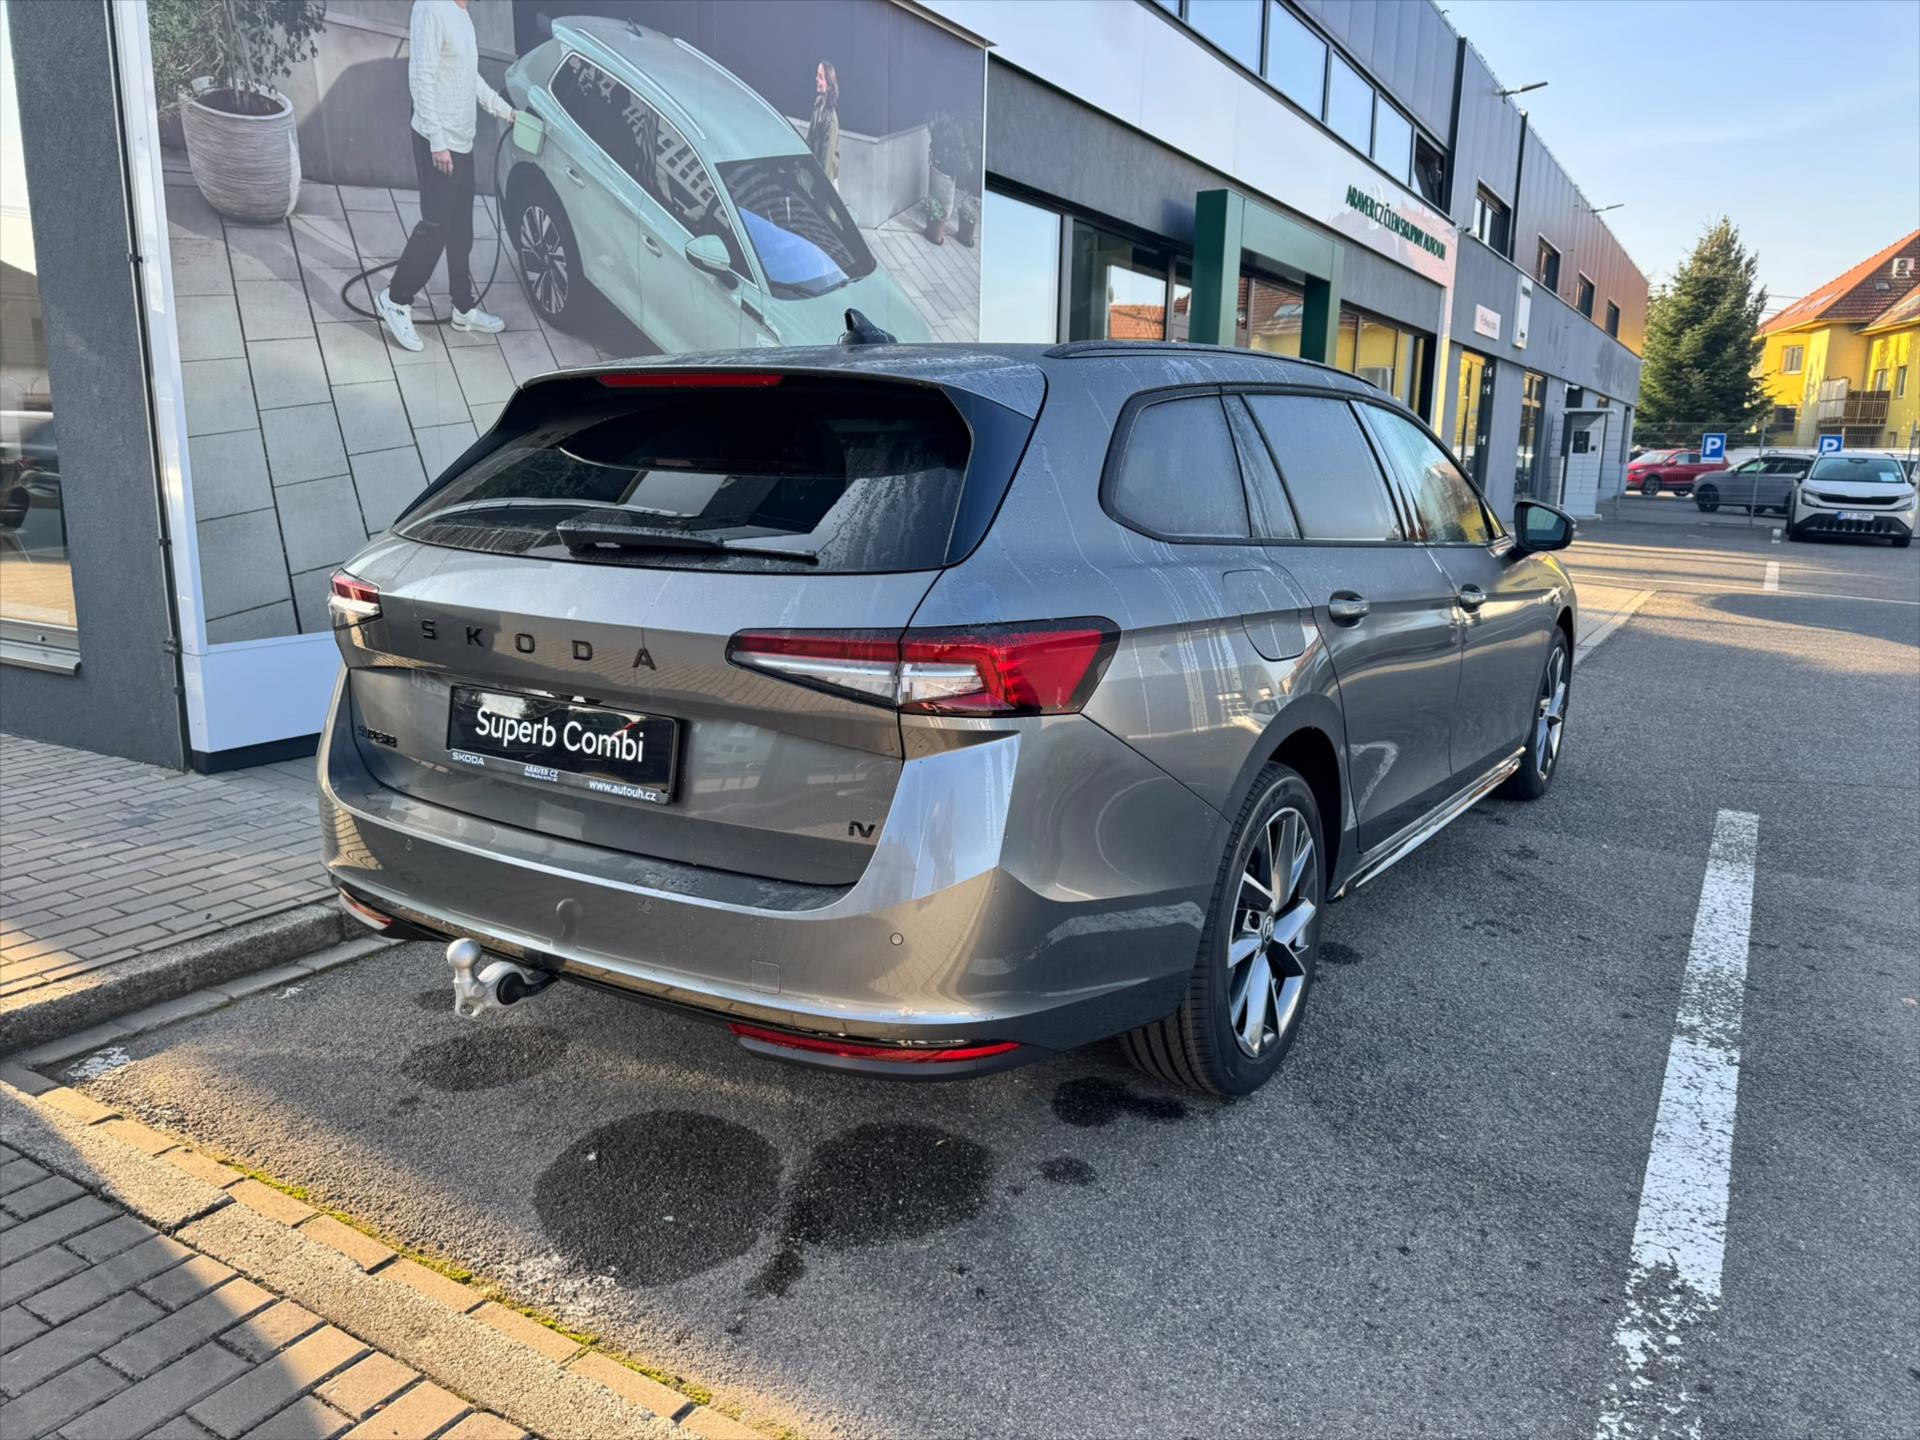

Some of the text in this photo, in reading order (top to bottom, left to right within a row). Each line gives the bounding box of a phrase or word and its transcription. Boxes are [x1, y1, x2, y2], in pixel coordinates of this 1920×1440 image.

[1705, 437, 1721, 455] P
[1821, 438, 1838, 453] P
[474, 709, 645, 764] Superb Combi
[588, 779, 657, 802] www.autouh.cz
